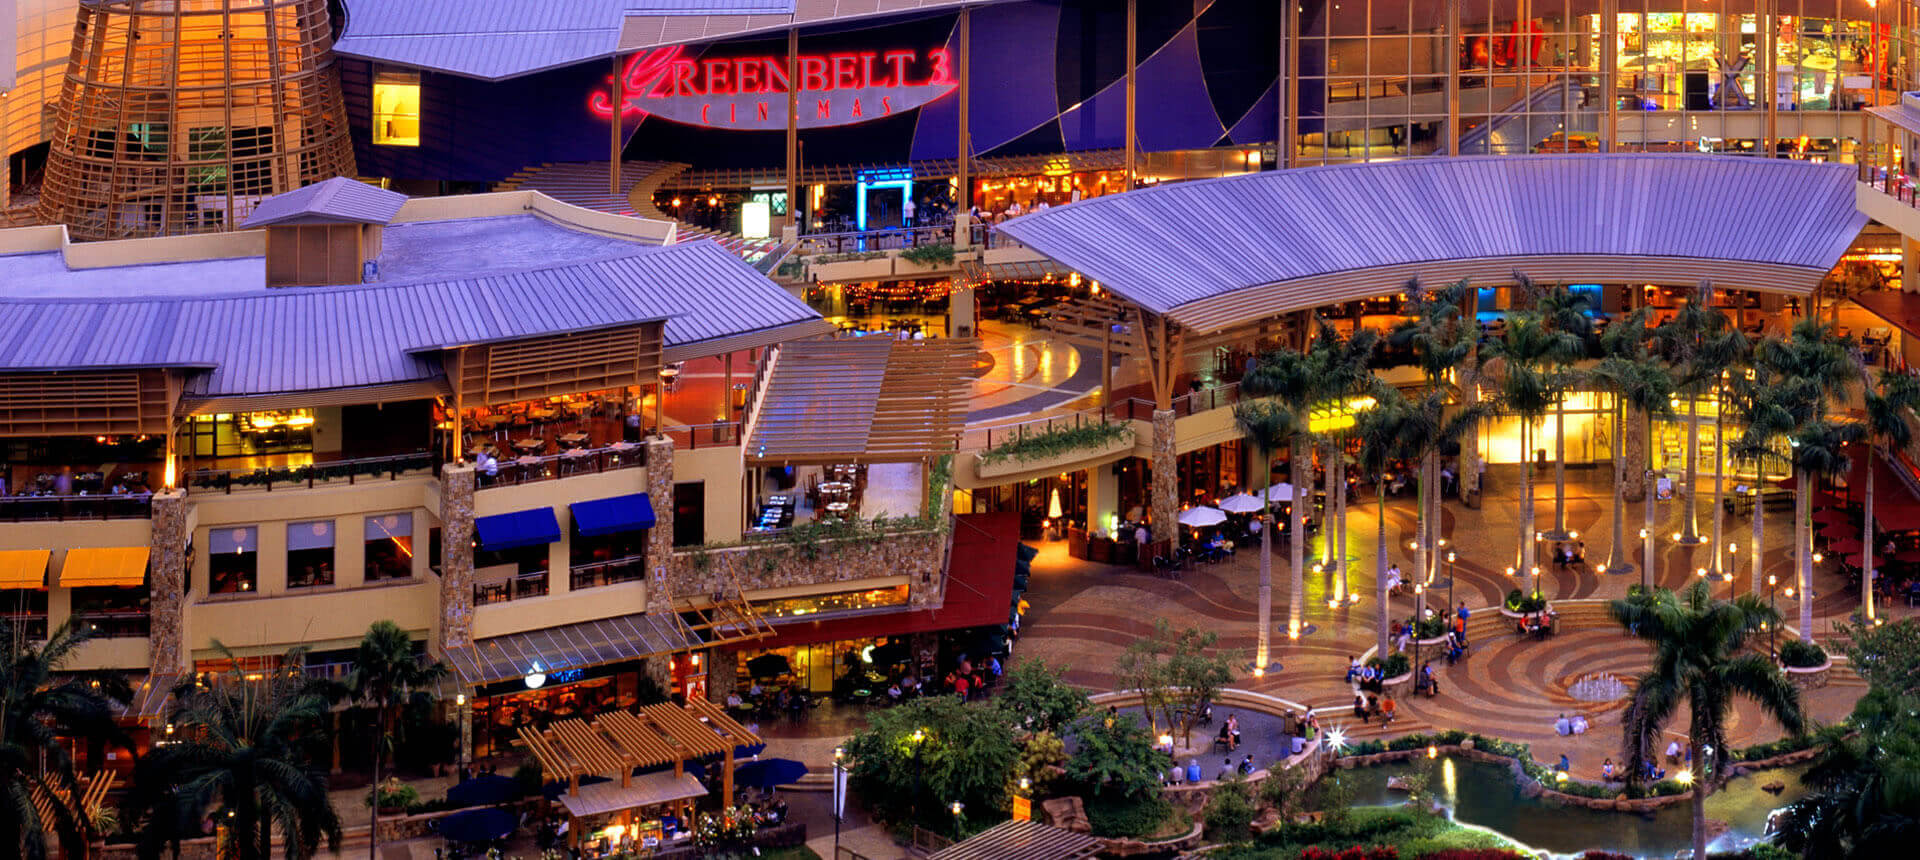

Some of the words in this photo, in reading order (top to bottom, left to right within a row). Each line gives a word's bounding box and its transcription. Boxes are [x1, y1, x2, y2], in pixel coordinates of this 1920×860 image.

[590, 45, 916, 112] GREENBELT
[927, 49, 951, 85] 3
[702, 96, 891, 124] CINMAS
